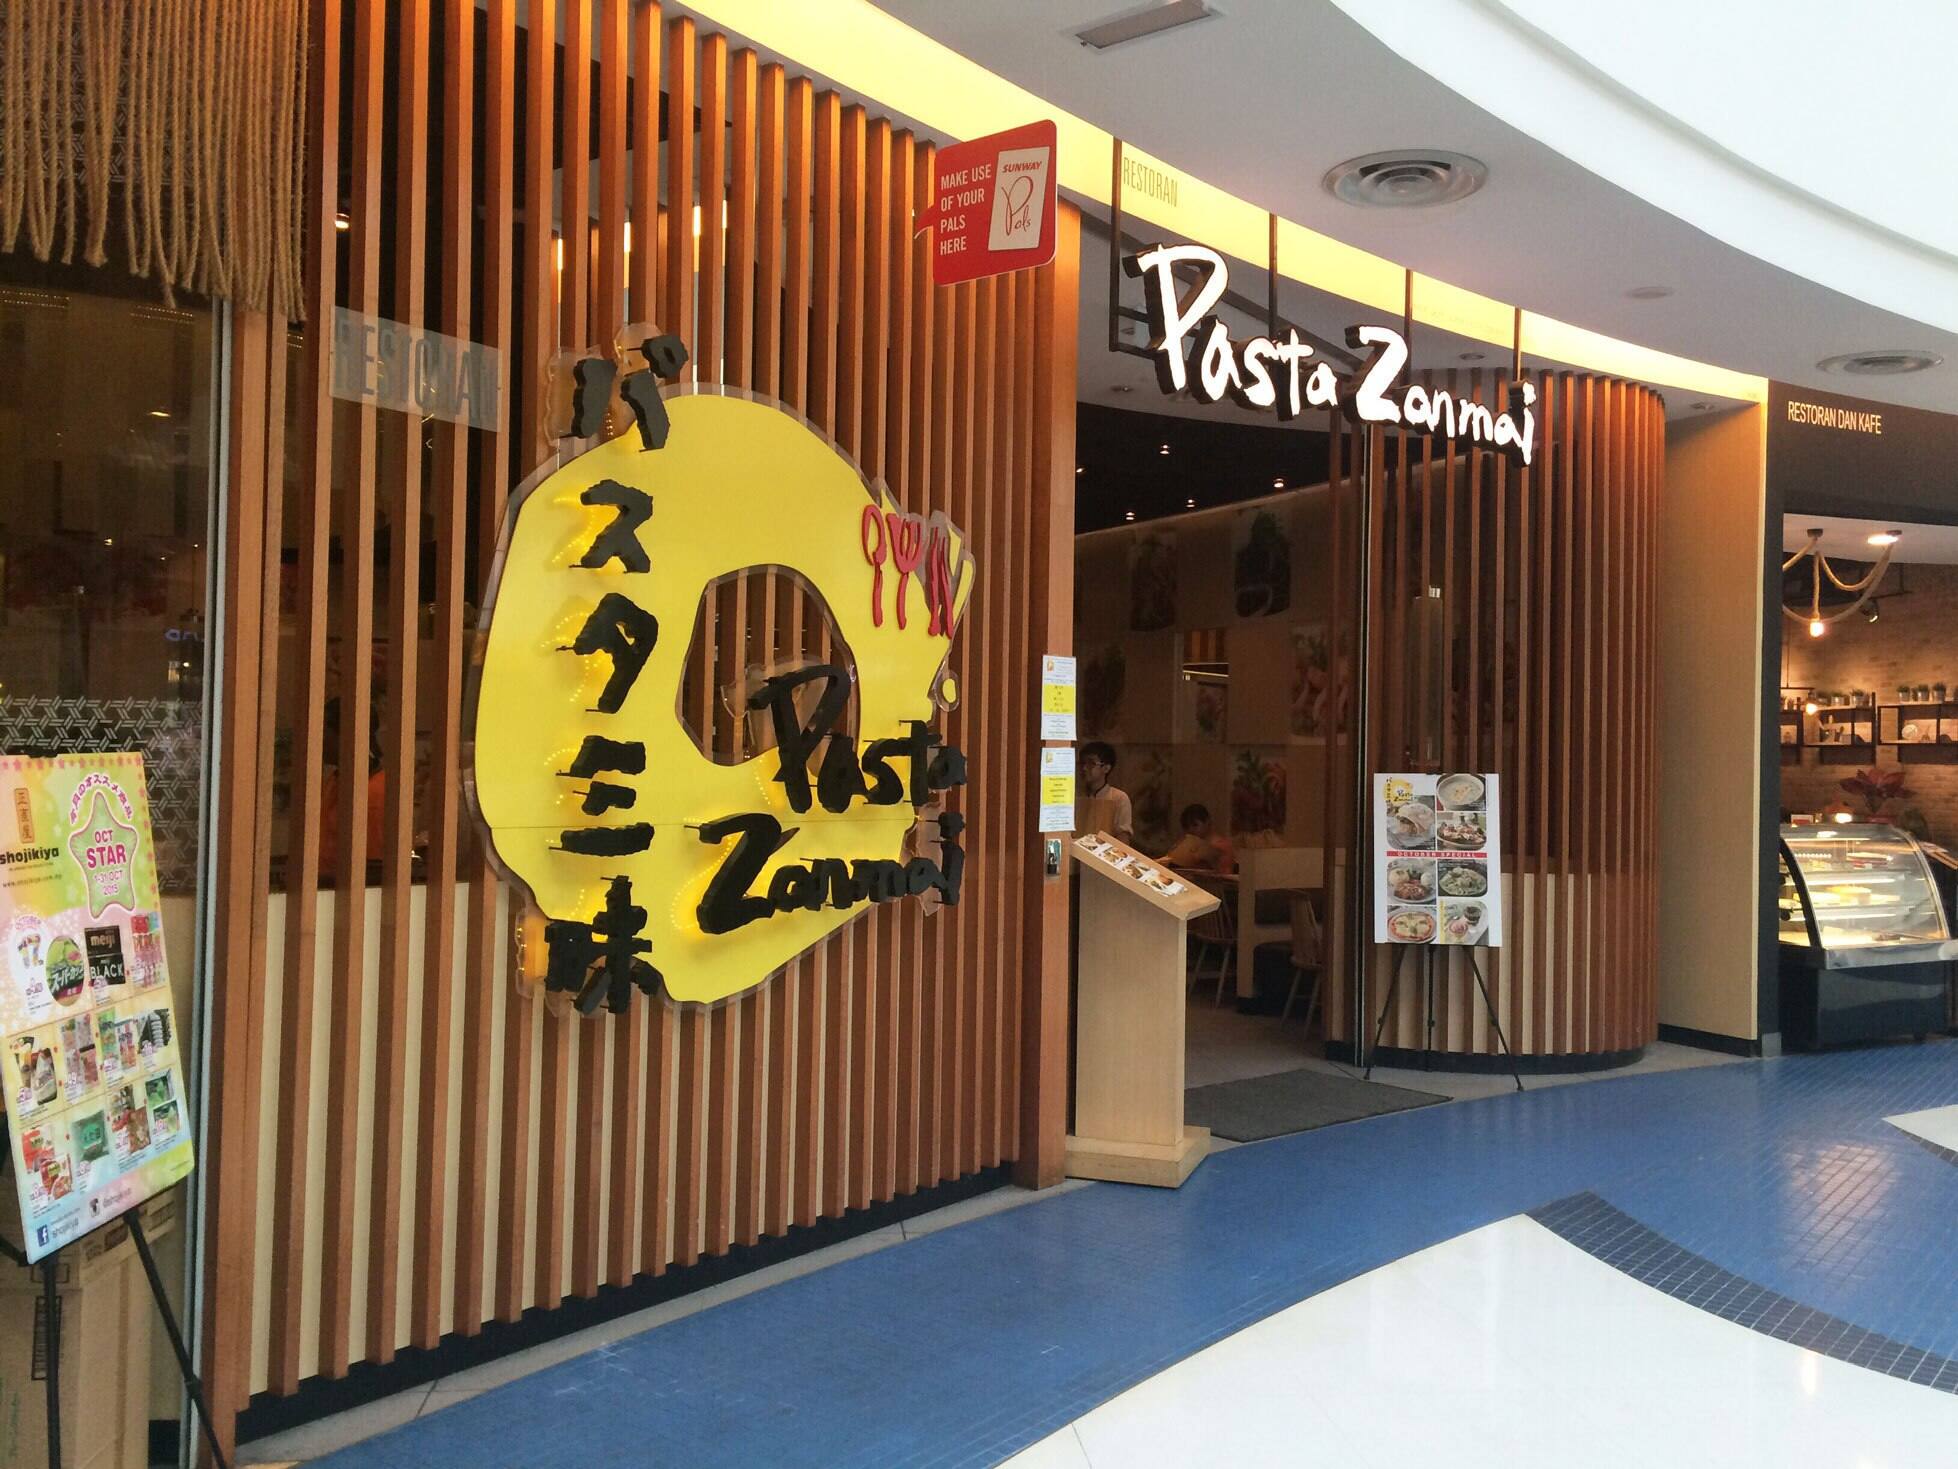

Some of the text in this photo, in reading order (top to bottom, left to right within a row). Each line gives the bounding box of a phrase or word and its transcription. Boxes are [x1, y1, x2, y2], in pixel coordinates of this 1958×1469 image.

[941, 164, 992, 190] MAKE USE
[1002, 161, 1042, 173] SUNWAY
[1124, 157, 1177, 207] RESTORAN
[941, 188, 984, 212] OF YOUR
[1001, 175, 1032, 236] Pals
[941, 214, 966, 234] PALS
[940, 236, 967, 256] HERE
[1134, 243, 1537, 466] Pasta Zanmai
[1788, 401, 1882, 434] RESTORAN DAN KAFE
[749, 664, 967, 814] Pasta
[94, 830, 113, 843] OCT
[0, 846, 59, 864] shojikiya
[86, 844, 127, 868] STAR
[696, 811, 966, 935] Zanmai
[90, 934, 115, 948] meiji
[90, 963, 124, 979] BLACK
